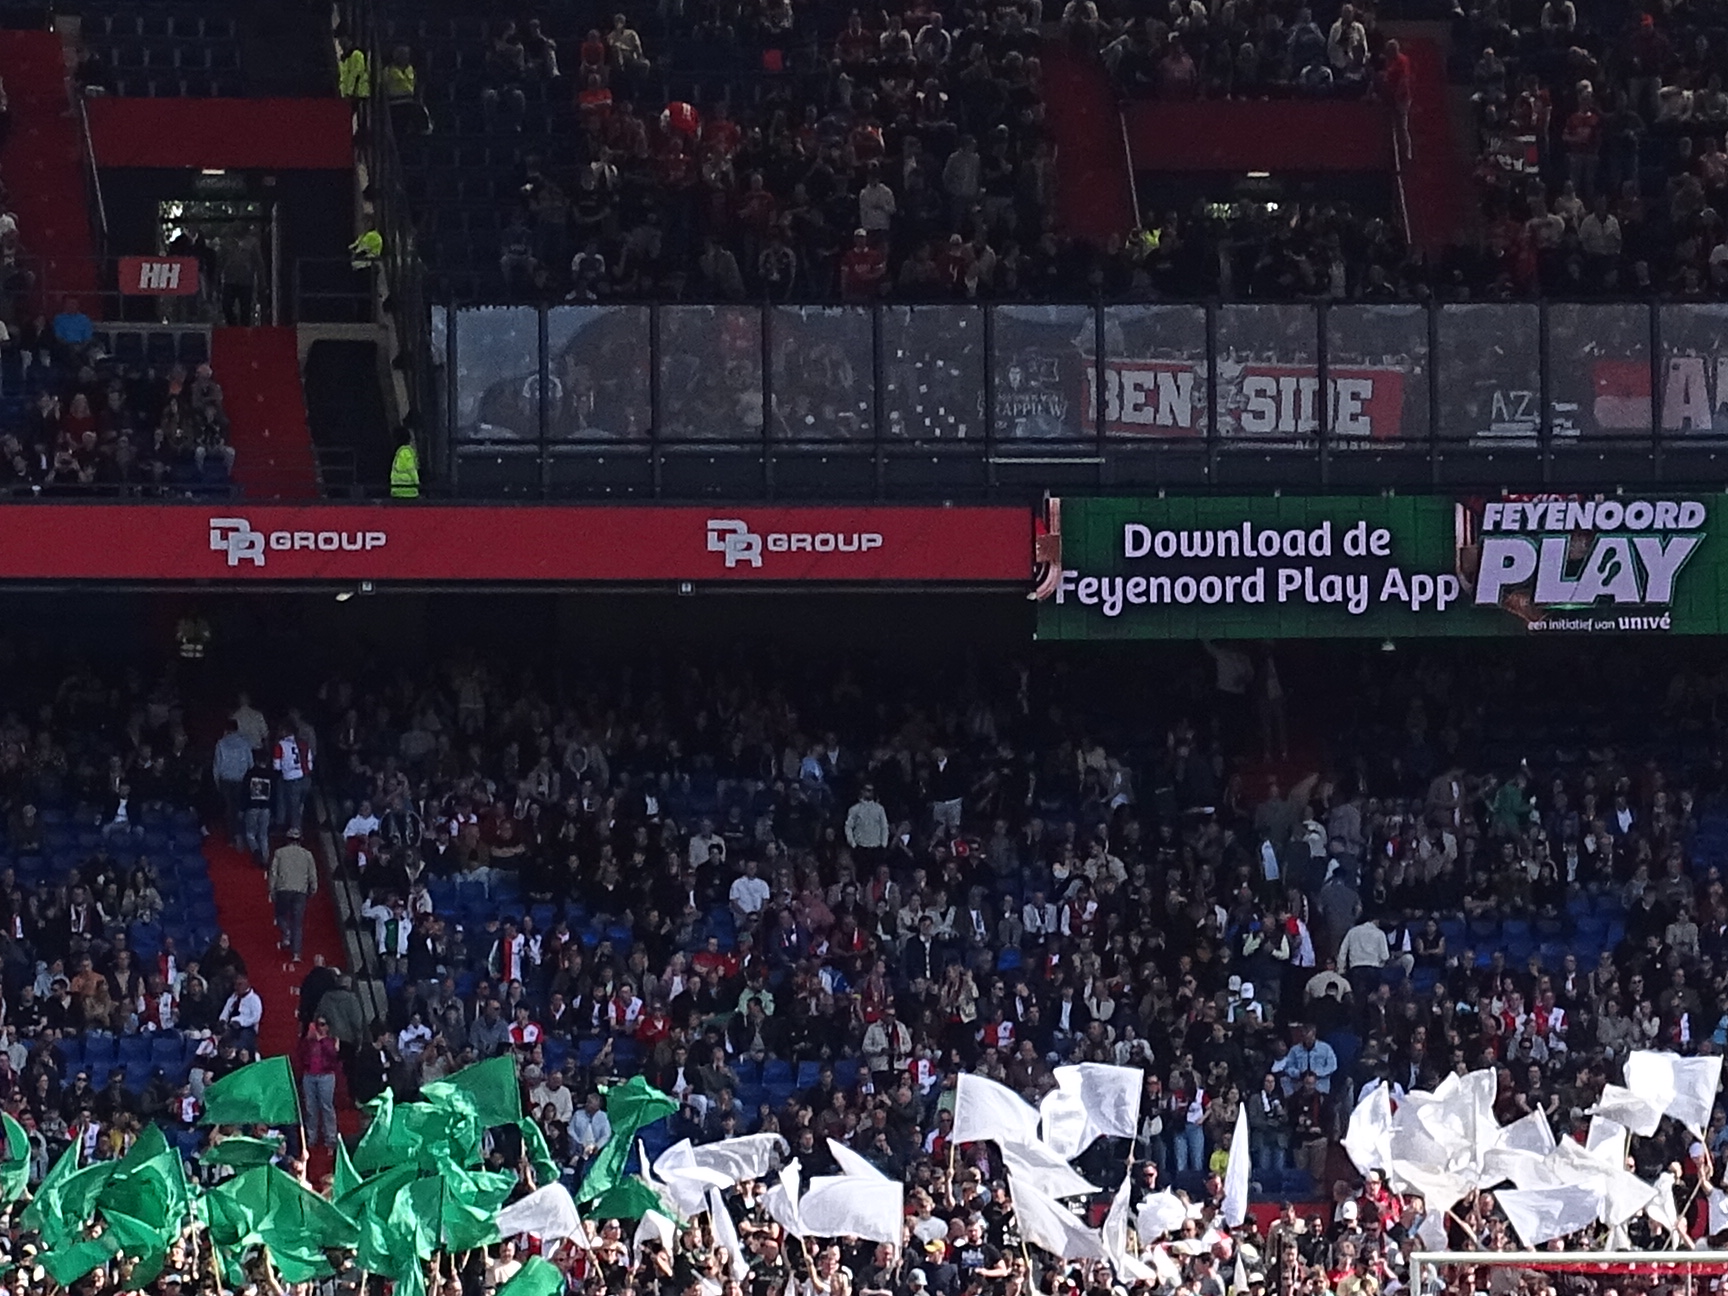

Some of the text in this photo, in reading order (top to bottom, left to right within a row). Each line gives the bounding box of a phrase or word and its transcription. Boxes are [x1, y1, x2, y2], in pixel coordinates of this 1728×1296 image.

[139, 263, 182, 290] HH
[1241, 374, 1373, 435] SIDE
[1482, 500, 1707, 532] FEYENOORD
[270, 532, 388, 552] GROUP
[768, 533, 884, 553] GROUP
[1124, 520, 1391, 559] Download de
[1474, 536, 1699, 604] PLAY
[1056, 566, 1460, 617] Feyenoord Play App
[1528, 620, 1547, 631] een
[1594, 620, 1616, 631] van
